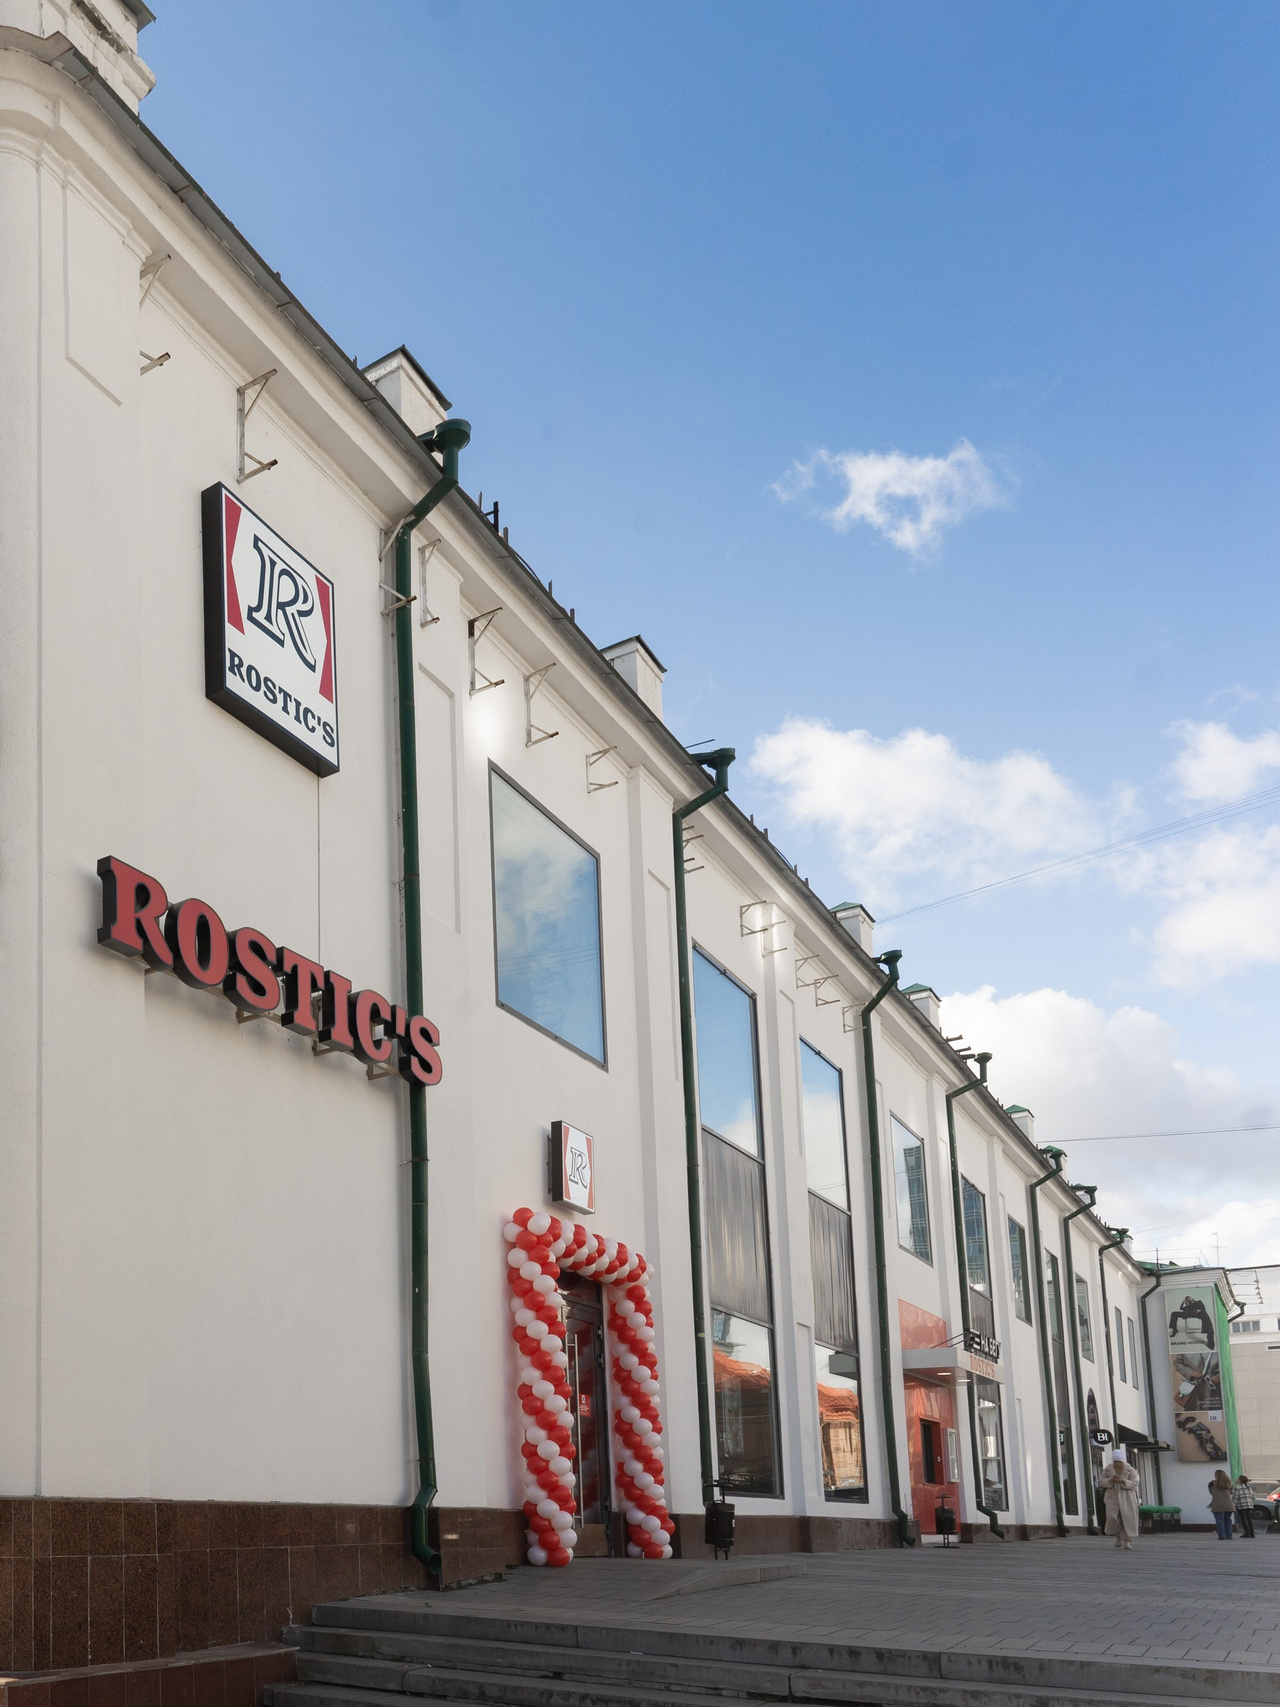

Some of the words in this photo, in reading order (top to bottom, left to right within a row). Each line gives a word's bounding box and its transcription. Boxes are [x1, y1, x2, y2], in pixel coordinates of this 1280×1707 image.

[247, 533, 316, 673] R
[228, 647, 335, 748] ROSTIC'S
[97, 855, 442, 1086] ROSTIC'S
[569, 1147, 588, 1189] R
